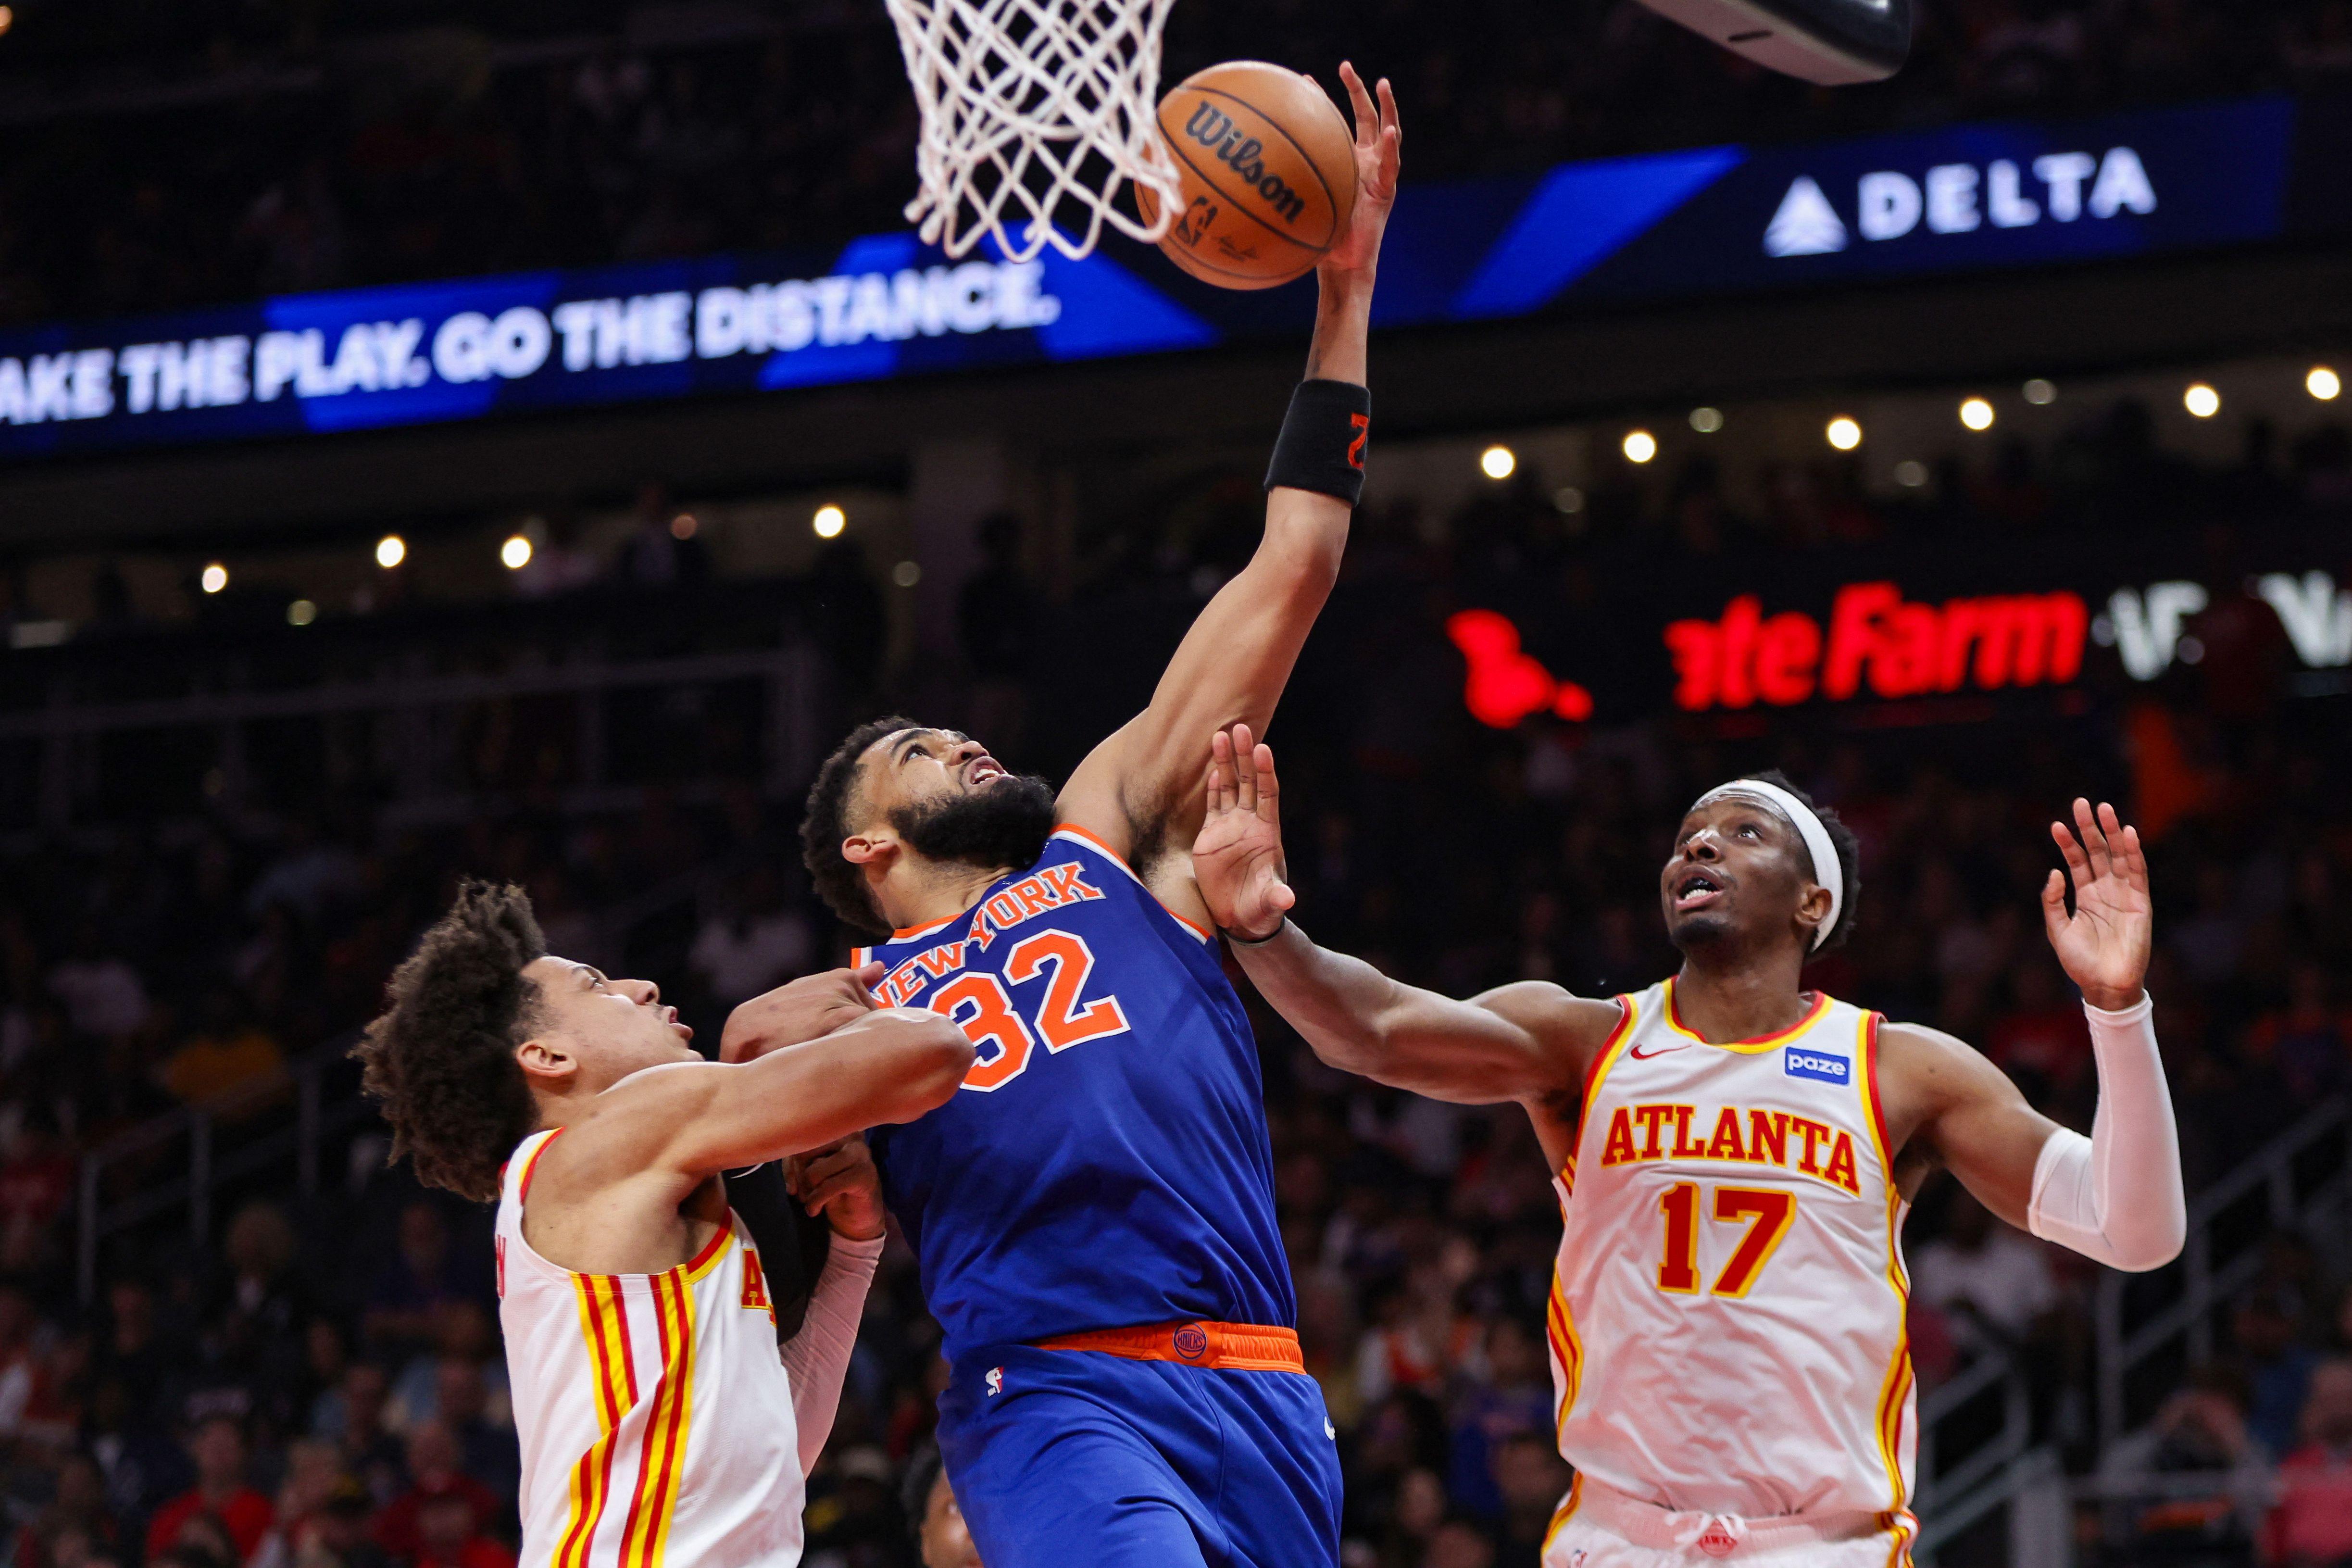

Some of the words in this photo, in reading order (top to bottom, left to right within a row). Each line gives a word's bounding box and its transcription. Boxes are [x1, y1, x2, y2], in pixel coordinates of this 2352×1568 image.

[1185, 100, 1305, 224] Wilson
[1857, 147, 2156, 240] DELTA
[118, 335, 250, 413] THE
[254, 318, 431, 401] PLAY.
[433, 306, 552, 384] GO
[552, 292, 691, 372] THE
[695, 259, 1062, 358] DISTANCE.
[1821, 581, 2087, 700] Farm
[964, 860, 1106, 953] YORK
[928, 928, 1131, 1092] 32
[1788, 1053, 1846, 1076] paze
[1601, 1104, 1861, 1198] ATLANTA
[1657, 1181, 1796, 1299] 17
